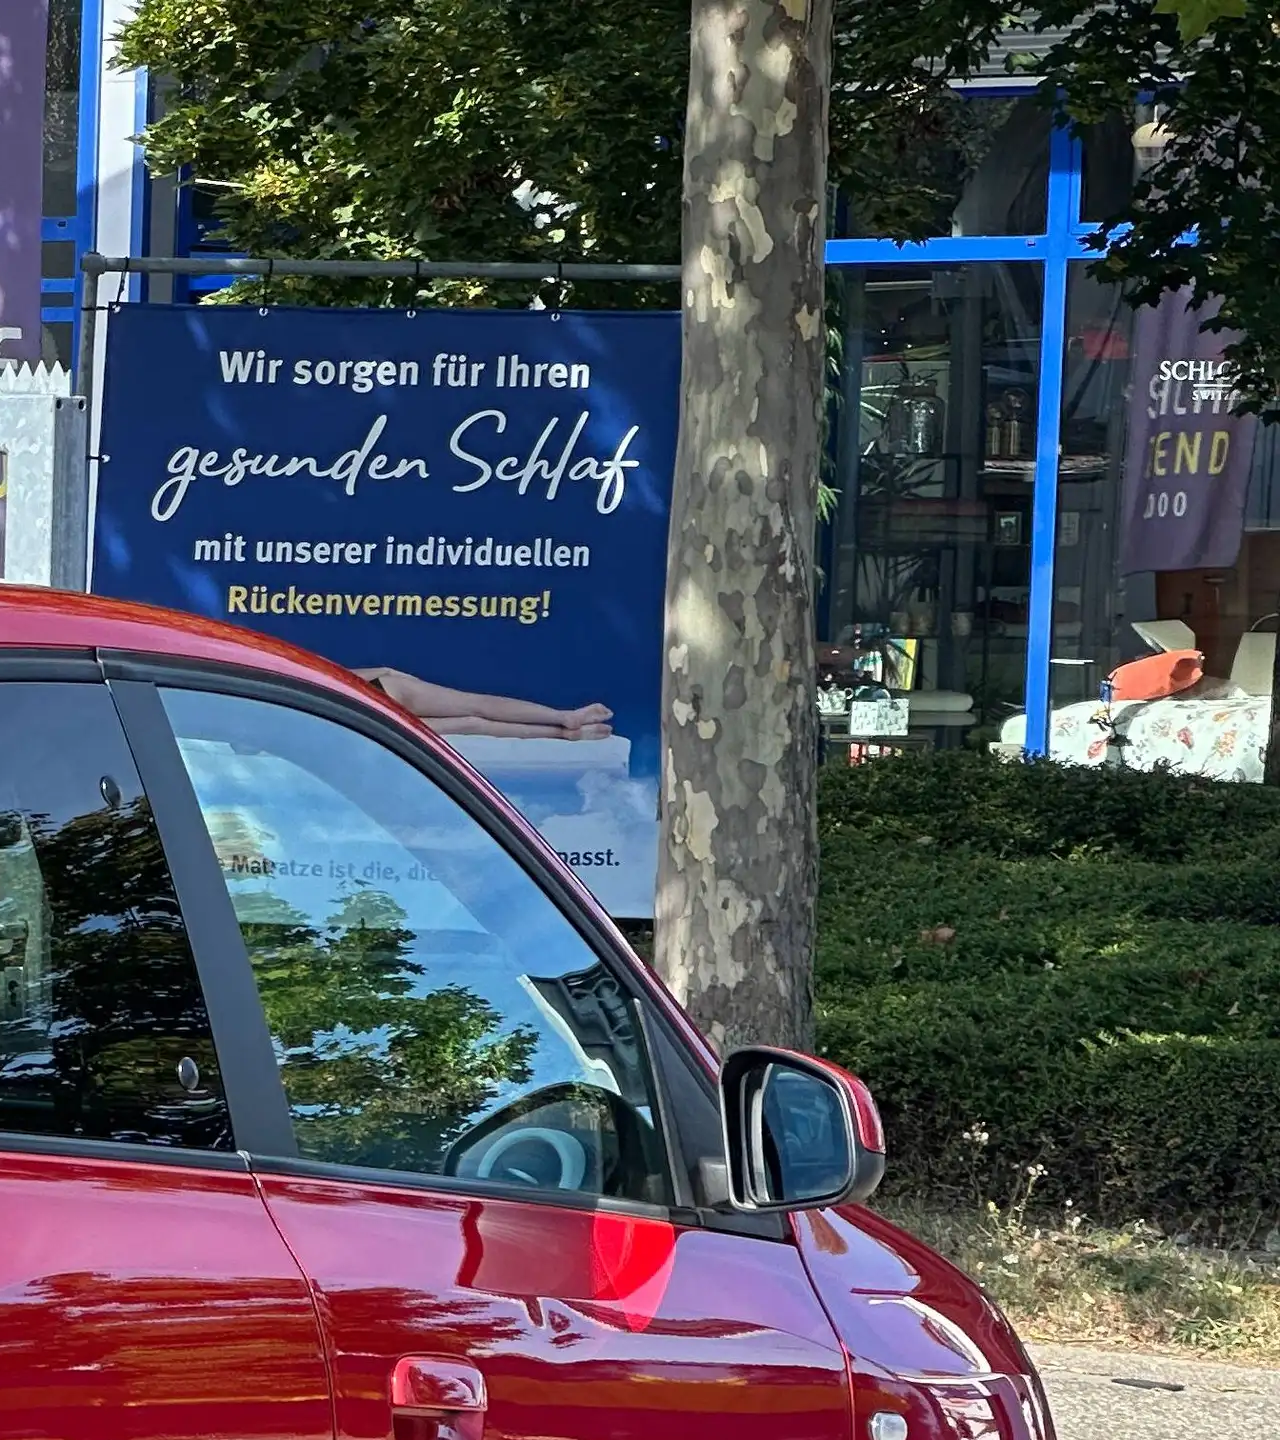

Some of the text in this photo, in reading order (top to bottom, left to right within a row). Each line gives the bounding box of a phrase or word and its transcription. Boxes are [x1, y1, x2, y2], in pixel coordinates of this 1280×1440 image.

[220, 351, 589, 392] Wir sorgen für Ihren
[152, 410, 639, 521] gesunden Schlaf
[195, 533, 589, 566] mit unserer individuellen
[227, 586, 551, 625] Rückenvermessung!
[329, 860, 355, 879] ist
